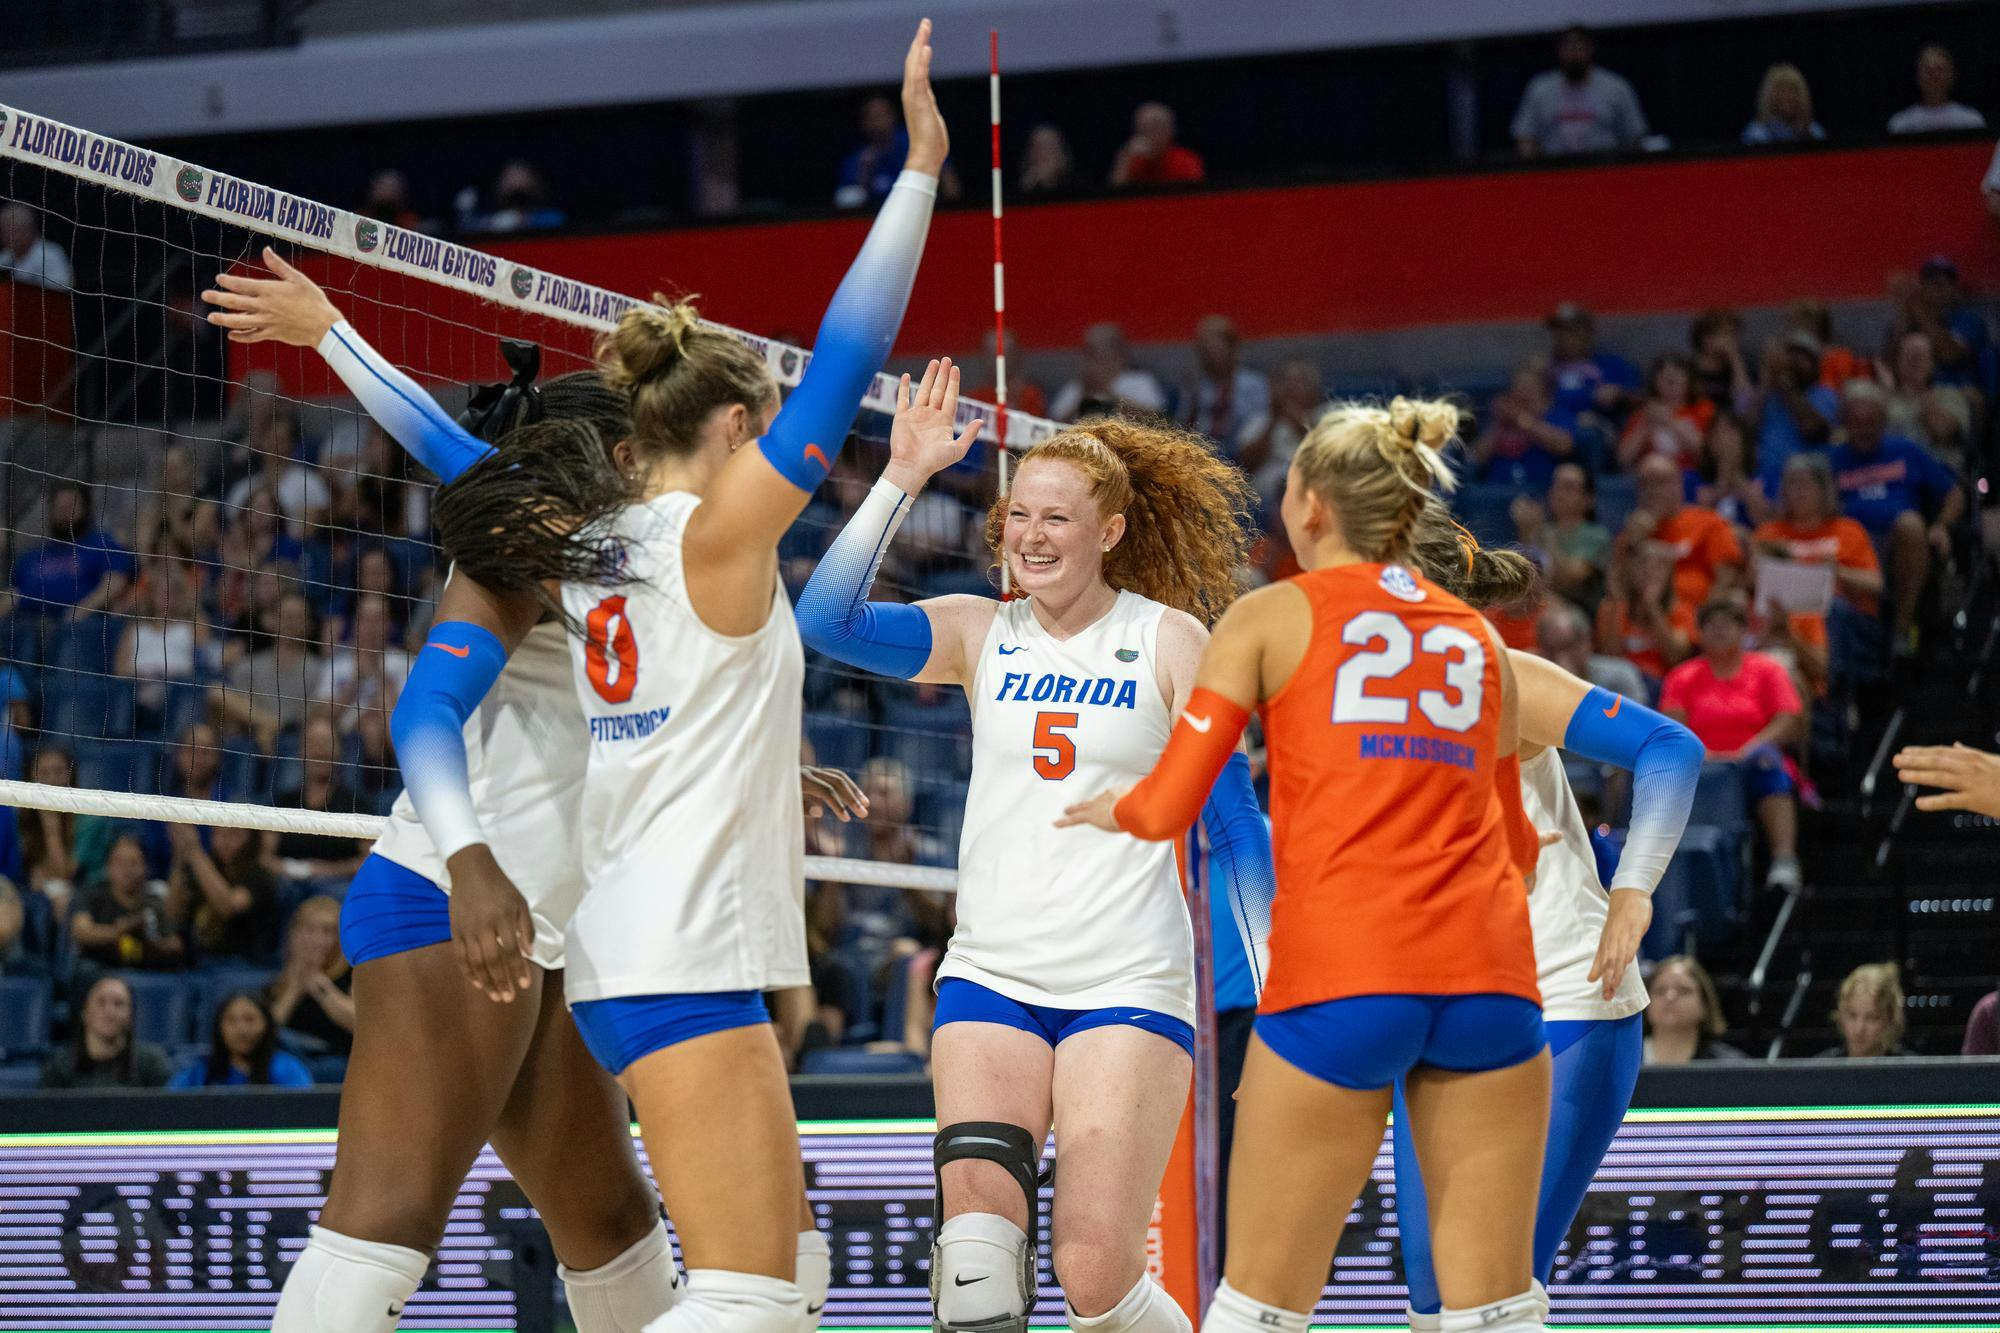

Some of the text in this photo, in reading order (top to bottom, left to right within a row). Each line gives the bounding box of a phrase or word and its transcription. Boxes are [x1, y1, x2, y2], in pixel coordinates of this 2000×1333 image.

[9, 113, 157, 187] FLORIDA GATORS
[206, 174, 336, 240] FLORIDA GATORS
[381, 225, 497, 288] FLORIDA GATORS
[536, 274, 591, 316] FLORIDA
[585, 594, 638, 705] 0
[1331, 610, 1486, 733] 23
[995, 672, 1137, 710] FLORIDA
[1033, 711, 1079, 781] 5
